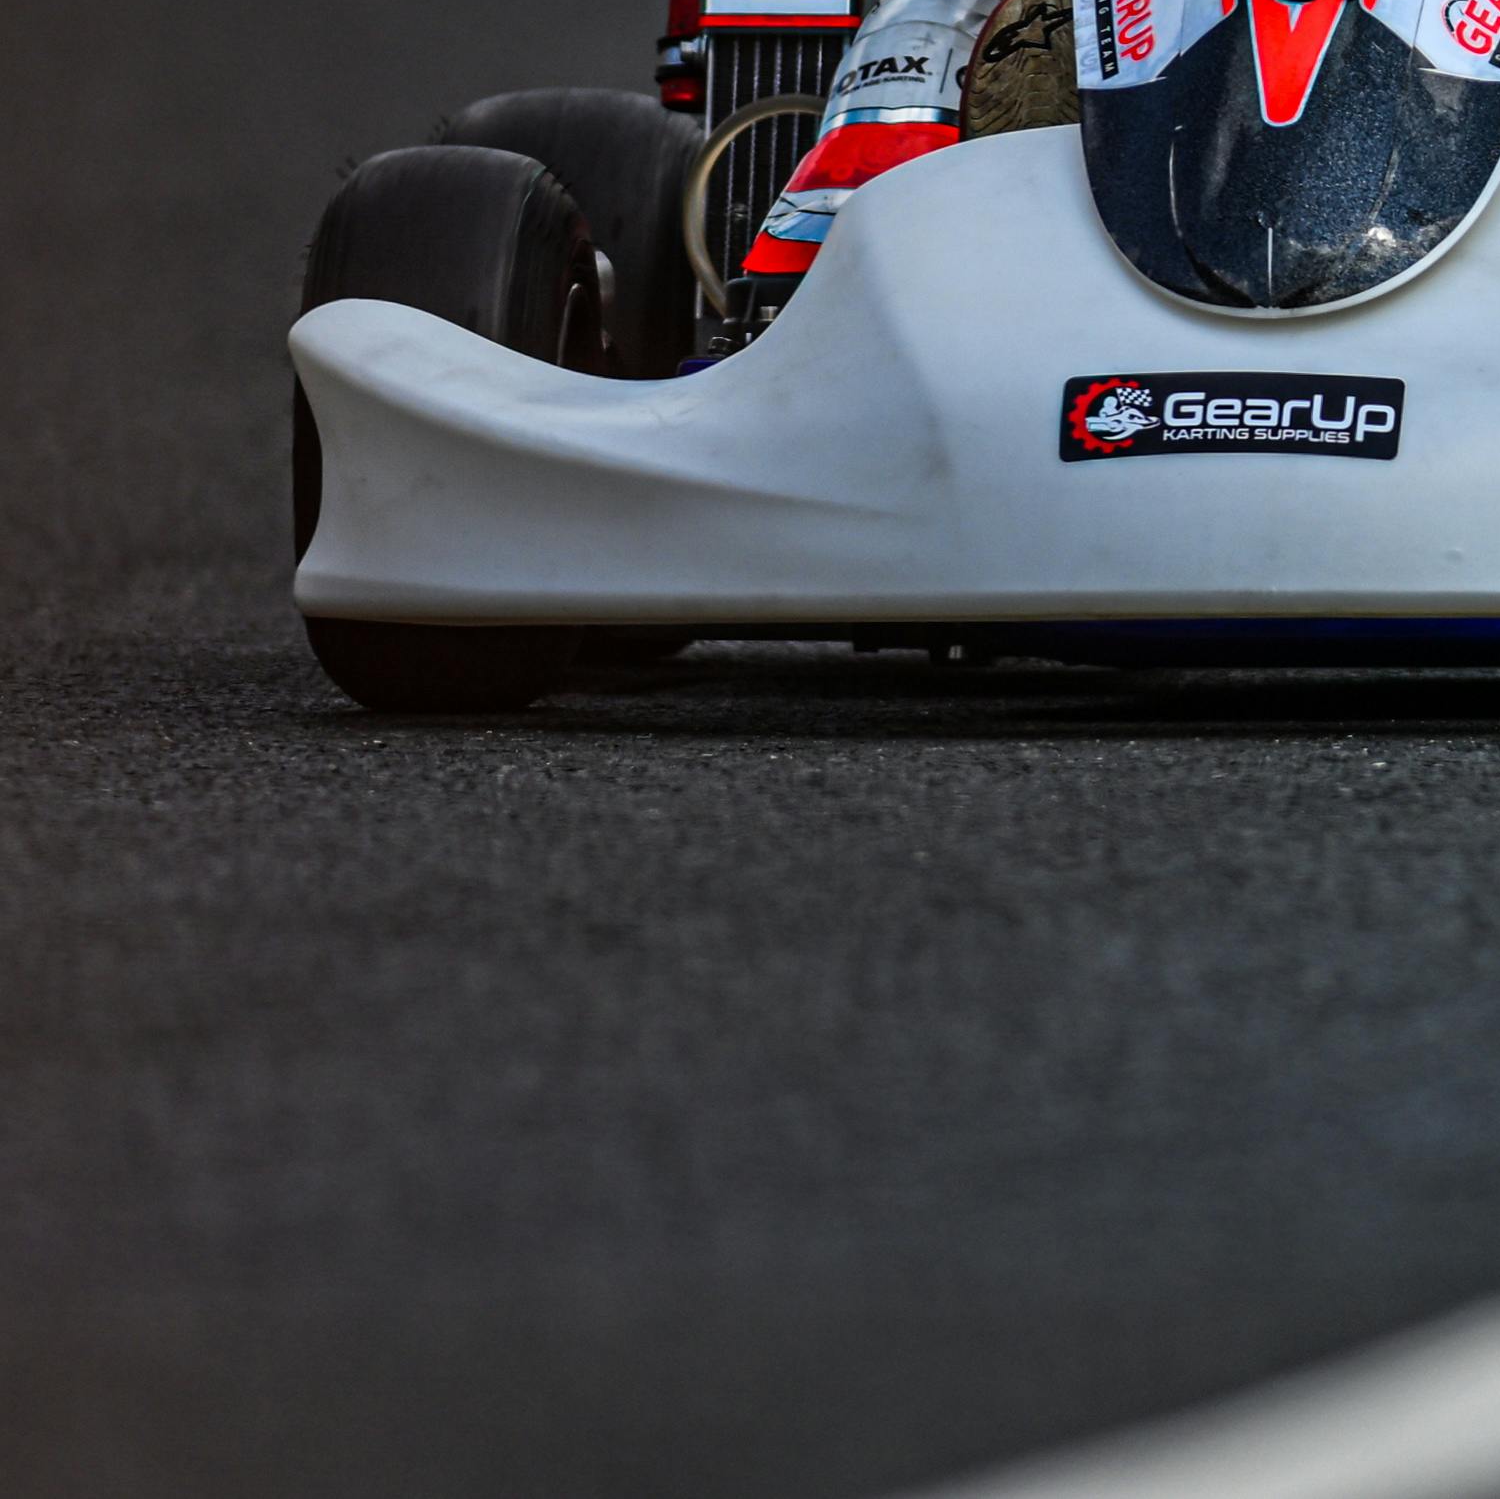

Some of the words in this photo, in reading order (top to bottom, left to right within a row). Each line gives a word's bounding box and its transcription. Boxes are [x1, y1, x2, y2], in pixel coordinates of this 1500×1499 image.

[1101, 26, 1115, 72] TEAM
[834, 56, 930, 95] OTAX
[1163, 392, 1396, 442] GearUp
[1163, 428, 1250, 441] KARTING
[1254, 429, 1350, 443] SUPPLIES
